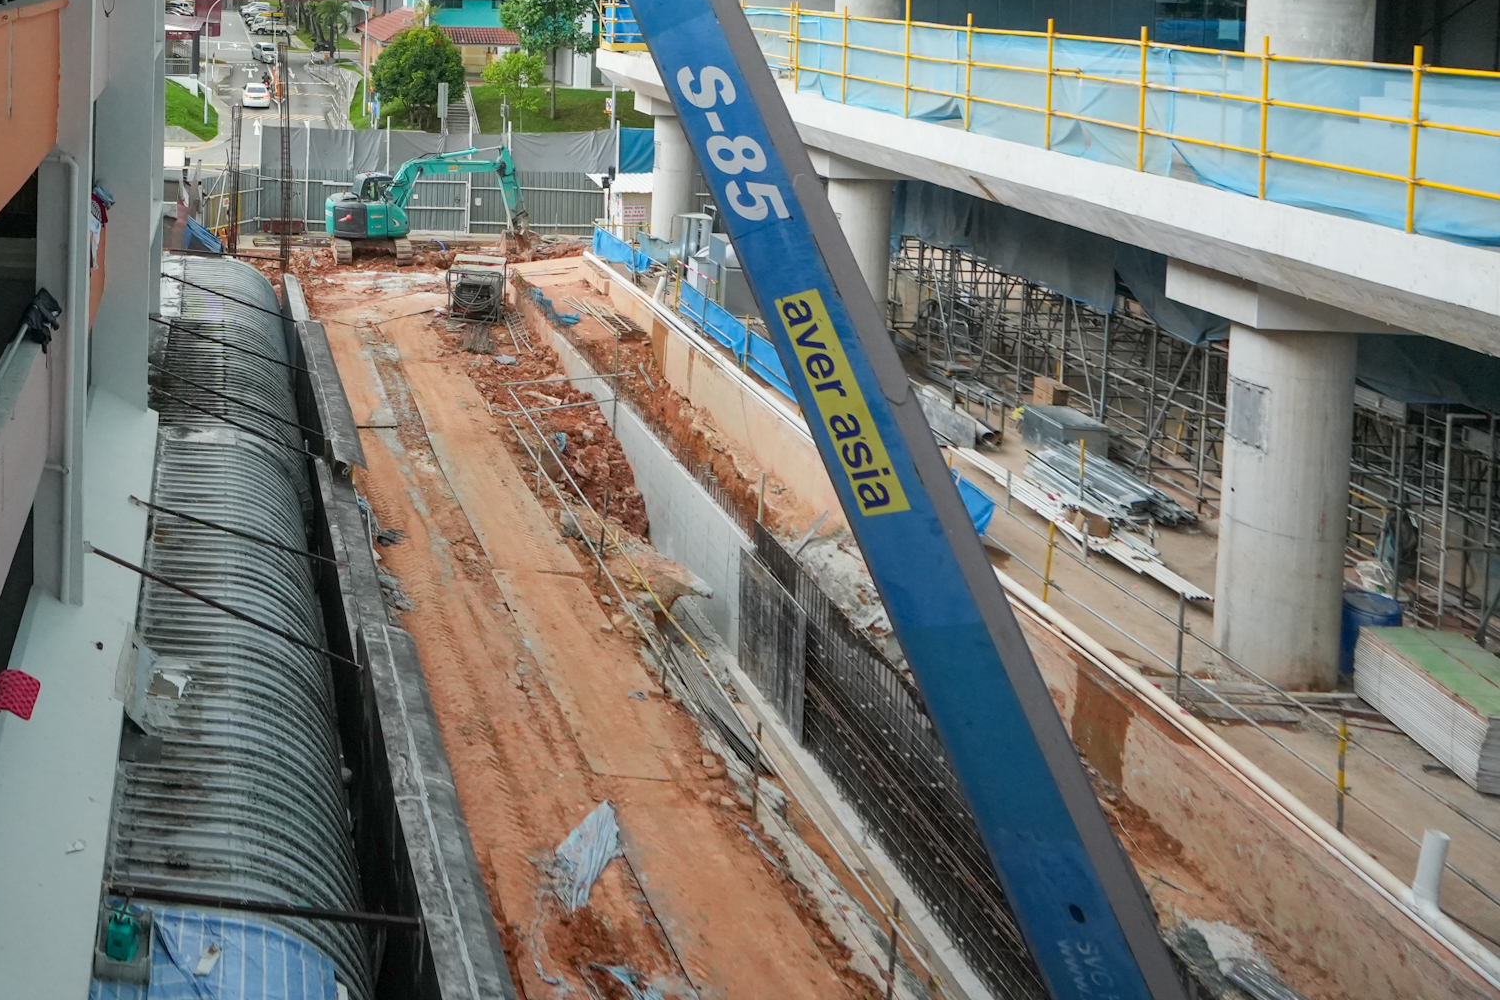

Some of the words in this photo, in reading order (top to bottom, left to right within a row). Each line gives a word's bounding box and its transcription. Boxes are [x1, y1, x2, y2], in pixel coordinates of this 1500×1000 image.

[677, 65, 790, 221] S-85
[782, 299, 847, 398] aver
[829, 413, 891, 510] asia
